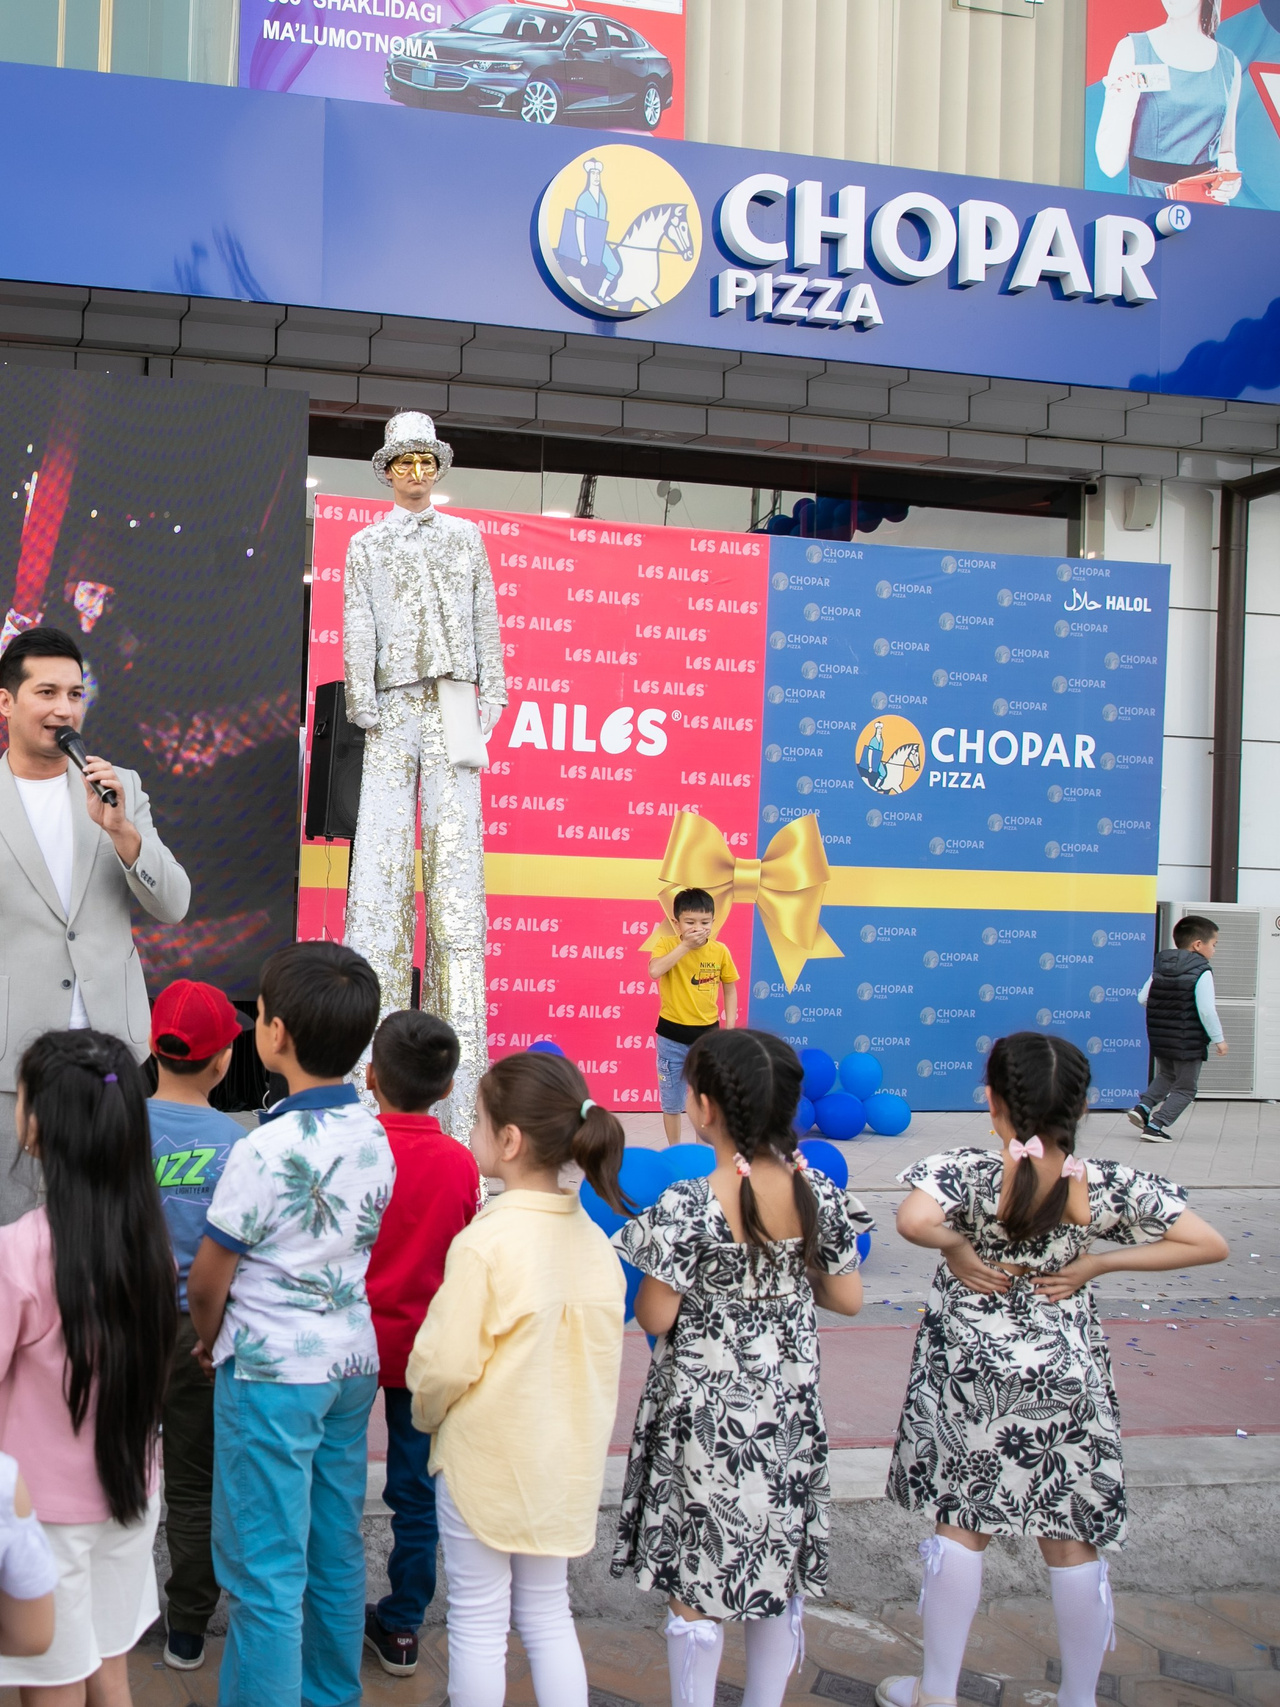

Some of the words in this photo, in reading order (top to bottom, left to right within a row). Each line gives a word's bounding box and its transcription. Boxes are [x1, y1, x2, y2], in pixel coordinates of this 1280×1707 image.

[718, 173, 1160, 304] CHOPAR
[715, 268, 885, 329] PIZZA
[570, 529, 596, 543] LES
[600, 531, 642, 547] AILES
[691, 539, 715, 552] LES
[720, 541, 760, 556] AILES
[823, 548, 863, 560] CHOPAR
[501, 553, 527, 568] LES
[532, 556, 574, 572] AILES
[958, 559, 996, 570] CHOPAR
[638, 565, 663, 579] LES
[668, 567, 708, 582] AILES
[1074, 567, 1111, 578] CHOPAR
[790, 575, 830, 586] CHOPAR
[892, 583, 931, 594] CHOPAR
[568, 588, 593, 602] LES
[598, 591, 639, 606] AILES
[1014, 591, 1052, 602] CHOPAR
[689, 597, 713, 611] LES
[717, 600, 757, 614] AILES
[1106, 595, 1152, 612] HALOL
[821, 606, 861, 618] CHOPAR
[529, 617, 572, 632] AILES
[956, 615, 994, 626] CHOPAR
[636, 625, 661, 638] LES
[665, 627, 706, 641] AILES
[1071, 623, 1108, 634] CHOPAR
[788, 634, 828, 646] CHOPAR
[890, 641, 929, 652] CHOPAR
[566, 648, 591, 662] LES
[596, 650, 637, 665] AILES
[1012, 648, 1050, 660] CHOPAR
[686, 656, 711, 670] LES
[715, 658, 755, 673] AILES
[1121, 655, 1157, 666] CHOPAR
[818, 663, 858, 674] CHOPAR
[949, 672, 987, 684] CHOPAR
[527, 678, 570, 693] AILES
[634, 680, 659, 694] LES
[663, 682, 704, 696] AILES
[1069, 679, 1106, 690] CHOPAR
[785, 688, 825, 700] CHOPAR
[888, 694, 927, 706] CHOPAR
[1010, 701, 1048, 712] CHOPAR
[1119, 706, 1156, 718] CHOPAR
[508, 701, 668, 757] AILES
[681, 715, 708, 729] LES
[713, 717, 753, 731] AILES
[816, 720, 856, 732] CHOPAR
[784, 747, 824, 758] CHOPAR
[931, 727, 1096, 769] CHOPAR
[1117, 755, 1154, 766] CHOPAR
[561, 765, 586, 779] LES
[591, 767, 632, 781] AILES
[681, 772, 706, 785] LES
[710, 773, 750, 787] AILES
[813, 779, 853, 790] CHOPAR
[929, 771, 986, 790] PIZZA
[1064, 788, 1101, 800] CHOPAR
[491, 795, 517, 809] LES
[522, 797, 564, 811] AILES
[628, 801, 654, 815] LES
[883, 812, 922, 824] CHOPAR
[1004, 816, 1042, 828] CHOPAR
[1114, 820, 1151, 832] CHOPAR
[558, 825, 583, 839] LES
[588, 827, 629, 840] AILES
[946, 840, 984, 852] CHOPAR
[1062, 843, 1099, 854] CHOPAR
[516, 918, 558, 932] AILES
[622, 921, 648, 935] LES
[877, 927, 916, 938] CHOPAR
[999, 930, 1037, 942] CHOPAR
[1109, 933, 1146, 944] CHOPAR
[552, 945, 578, 958] LES
[582, 946, 624, 959] AILES
[940, 953, 978, 964] CHOPAR
[1056, 955, 1093, 966] CHOPAR
[513, 979, 556, 992] AILES
[620, 981, 645, 994] LES
[874, 985, 913, 996] CHOPAR
[996, 987, 1034, 998] CHOPAR
[549, 1005, 574, 1017] LES
[579, 1005, 620, 1019] AILES
[801, 1008, 841, 1020] CHOPAR
[937, 1010, 975, 1022] CHOPAR
[1053, 1011, 1090, 1022] CHOPAR
[616, 1035, 642, 1049] LES
[871, 1037, 910, 1048] CHOPAR
[1104, 1039, 1141, 1050] CHOPAR
[934, 1062, 972, 1074] CHOPAR
[614, 1089, 639, 1102] LES
[1100, 1089, 1137, 1100] CHOPAR
